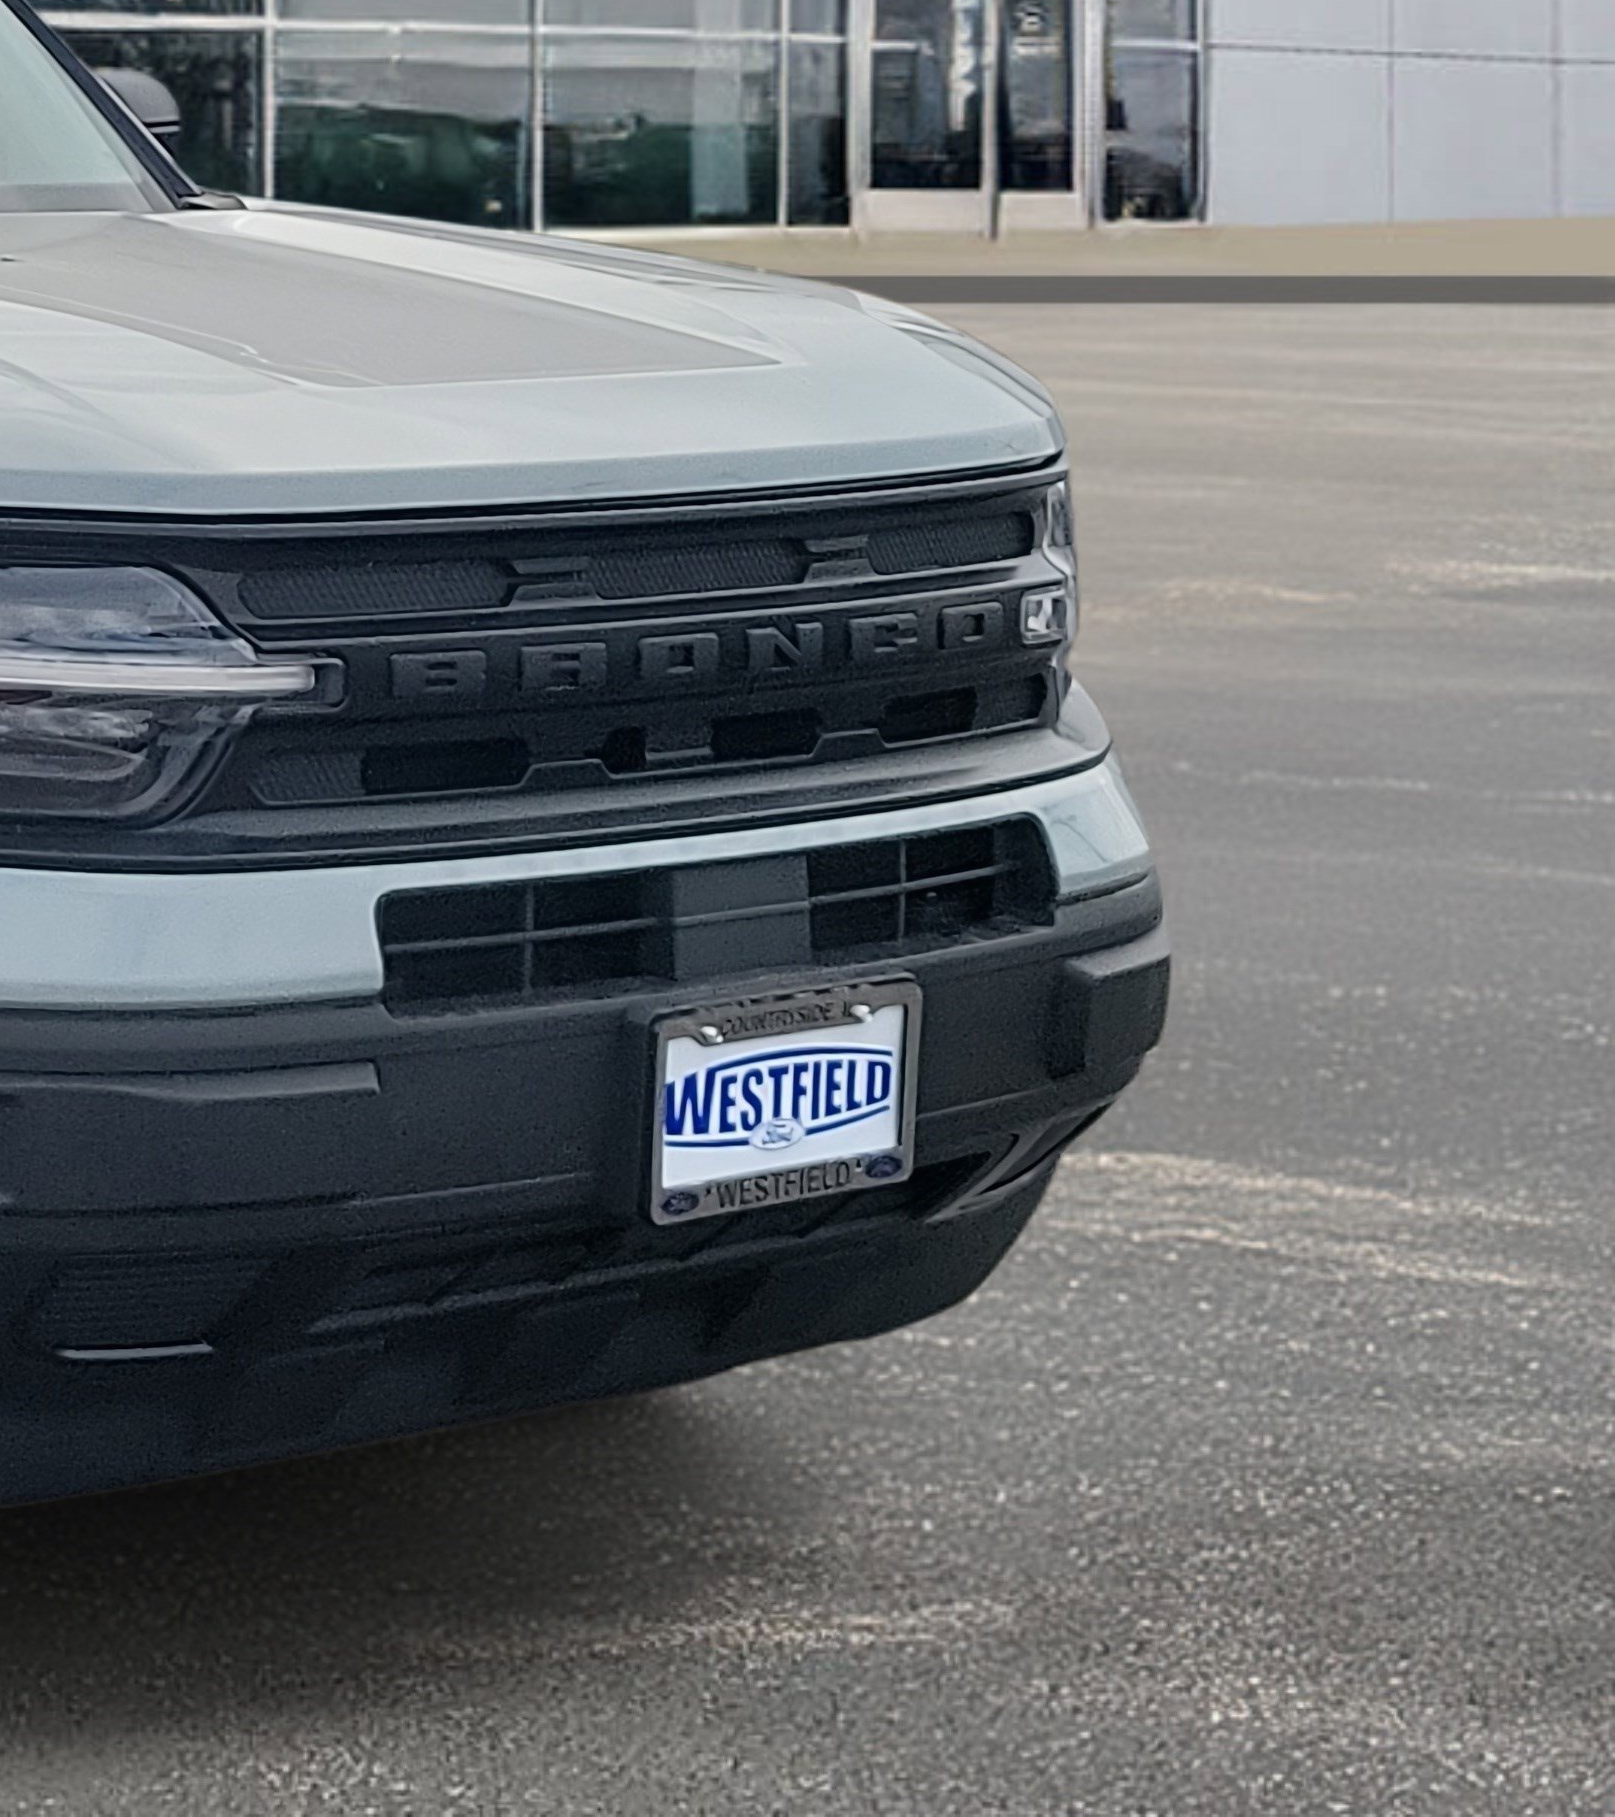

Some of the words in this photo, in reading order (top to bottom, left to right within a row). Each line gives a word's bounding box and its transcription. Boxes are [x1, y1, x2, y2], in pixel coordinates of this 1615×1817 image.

[390, 602, 1003, 700] BRONCO
[663, 1059, 892, 1136] WESTFIELD
[716, 1161, 851, 1208] WESTFIELD
